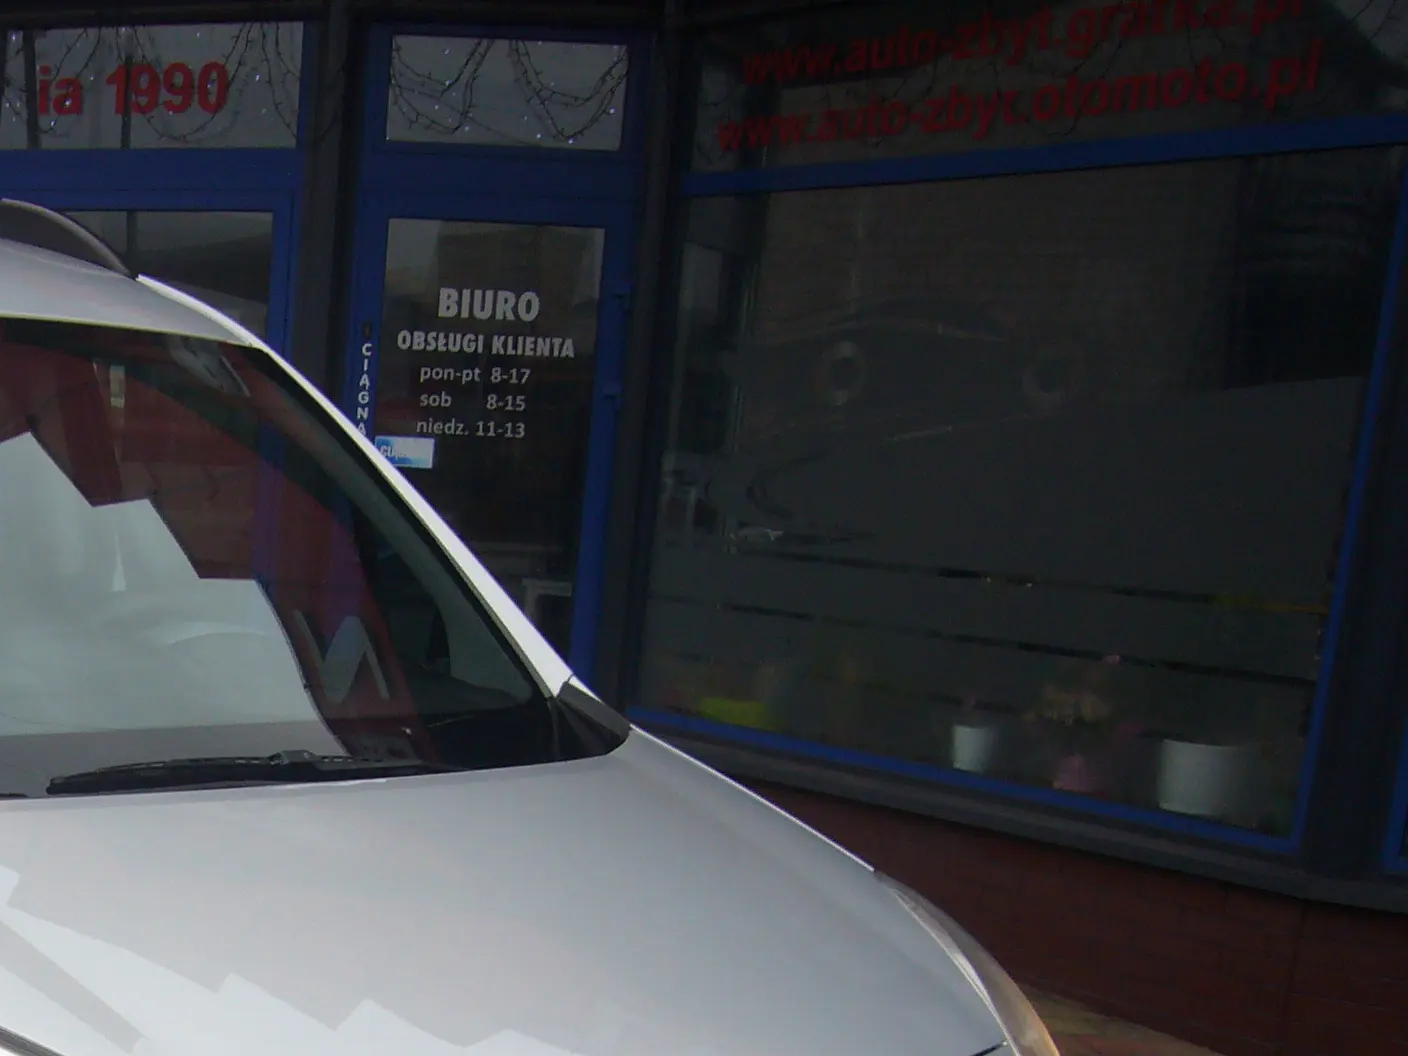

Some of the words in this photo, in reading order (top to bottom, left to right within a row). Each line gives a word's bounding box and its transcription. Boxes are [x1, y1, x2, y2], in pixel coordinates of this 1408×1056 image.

[105, 60, 229, 114] 1990
[717, 38, 1324, 152] www.auto-zbyt.otomoto.pl
[438, 287, 540, 322] BIURO
[397, 330, 484, 353] OBSŁUGI
[491, 334, 576, 358] KLIENTA
[420, 366, 481, 385] pon-pt
[490, 367, 531, 385] 8-17
[419, 391, 452, 408] sob
[486, 394, 527, 411] 8-15
[416, 418, 469, 436] niedz.
[475, 421, 526, 438] 11-13
